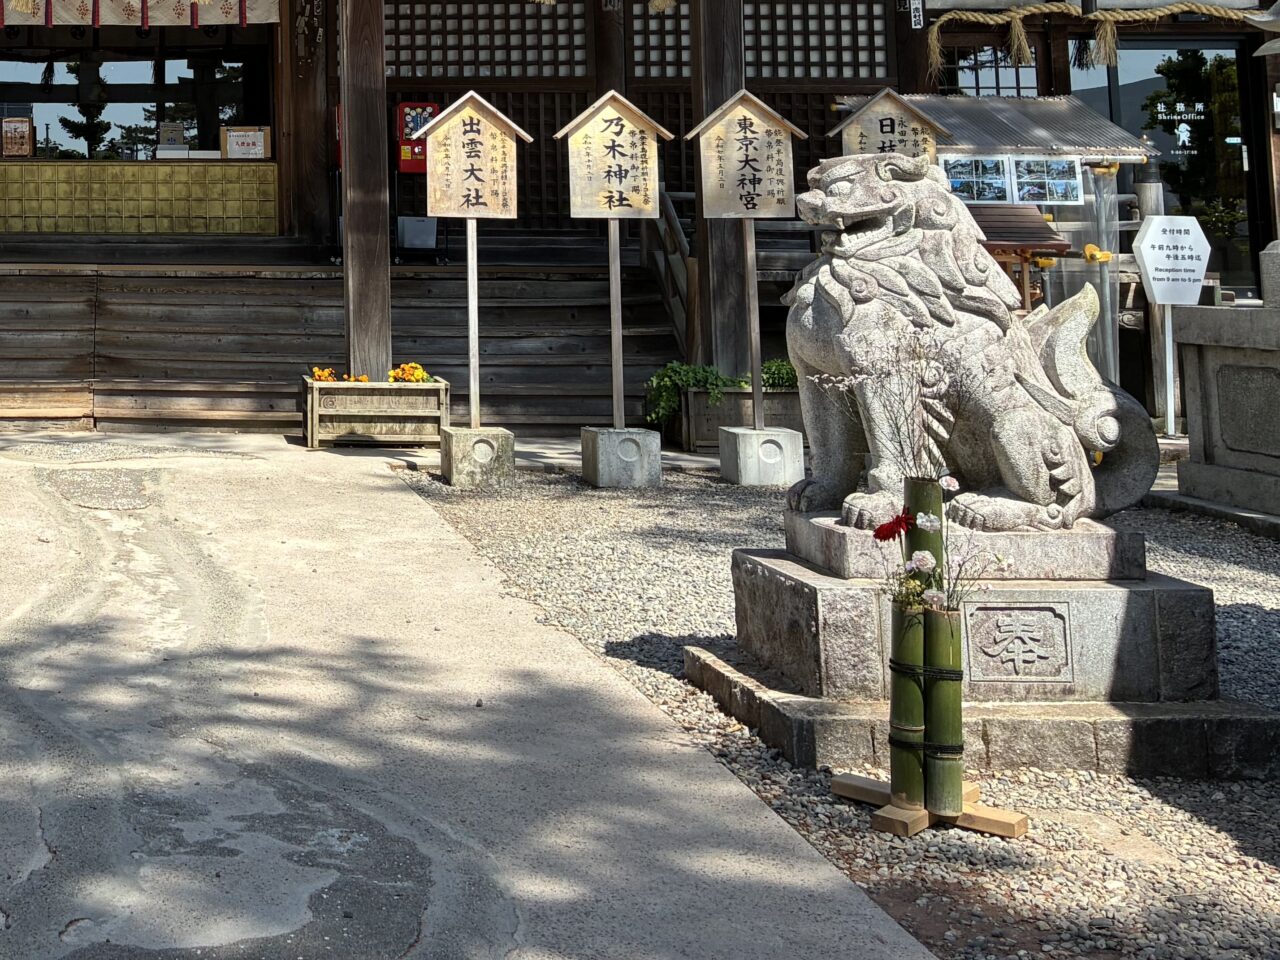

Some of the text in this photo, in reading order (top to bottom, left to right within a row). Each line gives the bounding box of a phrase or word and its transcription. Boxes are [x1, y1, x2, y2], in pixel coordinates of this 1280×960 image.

[897, 116, 909, 148] 永田町
[460, 115, 488, 209] 出雲大社
[600, 115, 633, 211] 乃木神社
[734, 114, 763, 211] 東京大神宮
[1161, 227, 1191, 236] 受付時間
[1150, 244, 1194, 252] 午前九時から
[1165, 253, 1202, 262] 午後五時迄
[1154, 266, 1182, 274] Reception
[976, 611, 1052, 677] 奉
